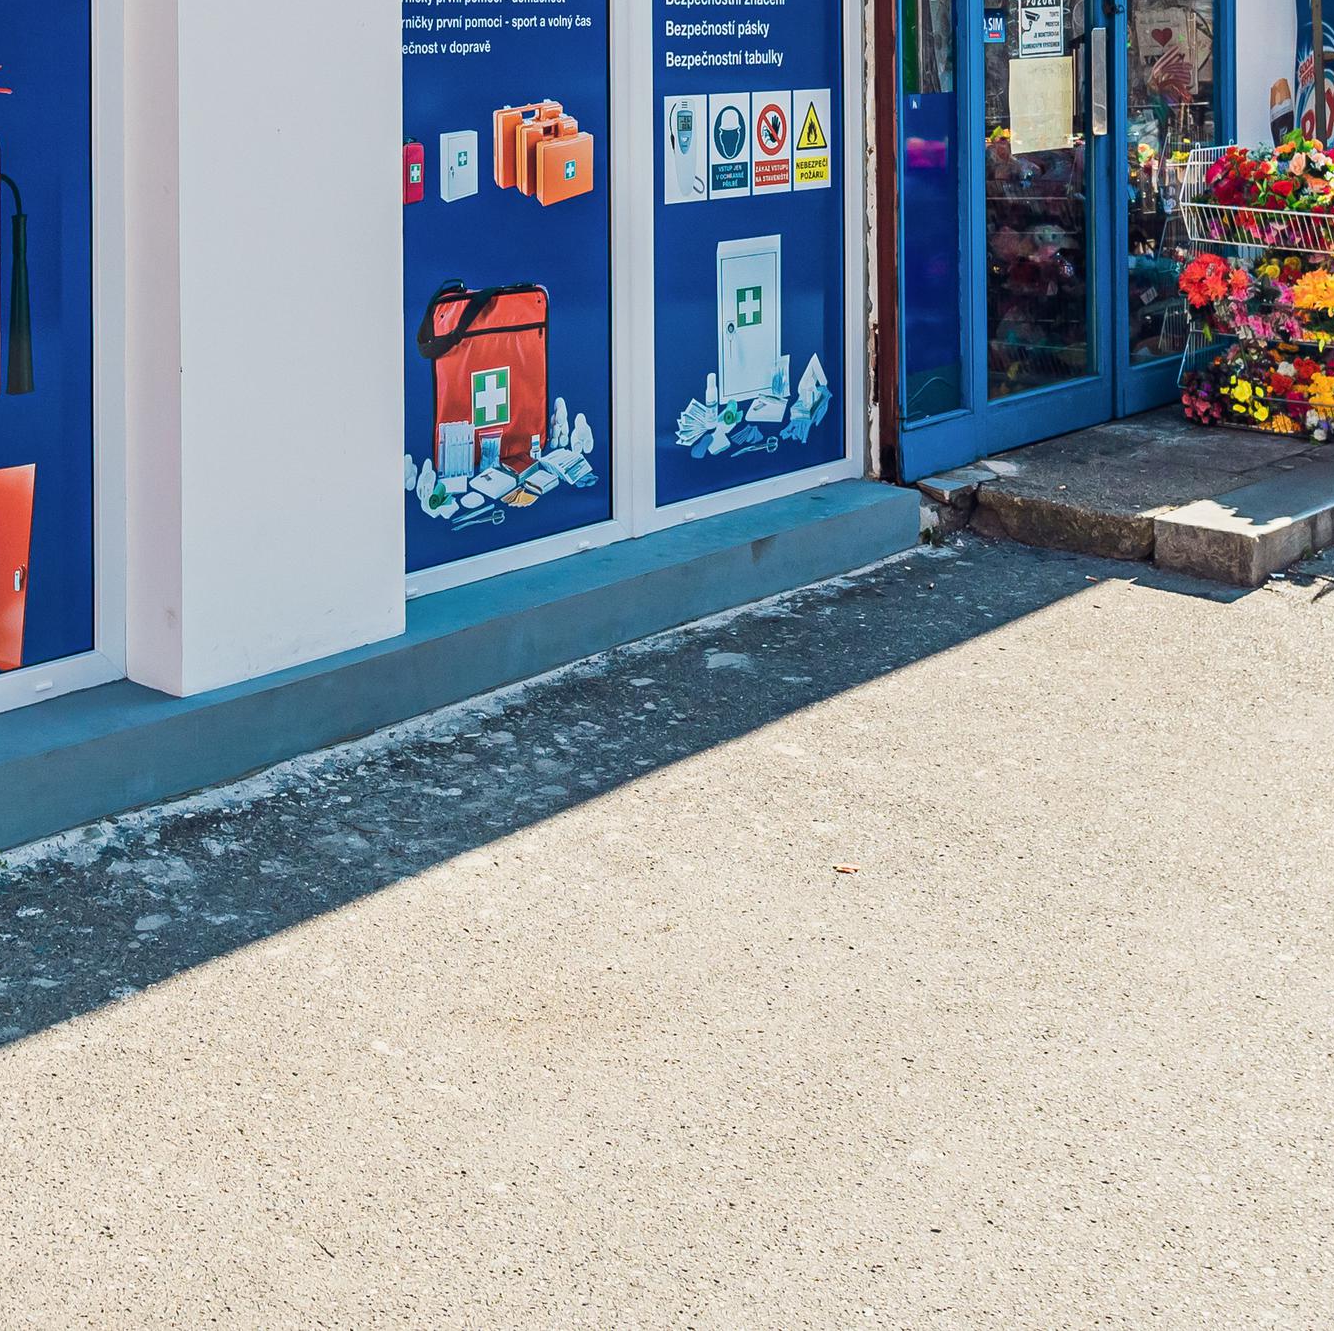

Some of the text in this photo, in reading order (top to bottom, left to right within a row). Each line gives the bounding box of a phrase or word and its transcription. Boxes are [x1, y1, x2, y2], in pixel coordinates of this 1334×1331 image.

[436, 16, 462, 31] první
[464, 15, 503, 31] pomoci
[511, 15, 537, 30] sport
[539, 18, 546, 27] a
[548, 15, 573, 30] volný
[575, 15, 592, 27] čas
[738, 20, 770, 40] pásky
[988, 17, 1003, 31] SIM
[440, 44, 447, 54] v
[449, 40, 491, 56] dopravě
[665, 49, 784, 70] Bezpečnostní tabulky
[755, 162, 789, 173] ZÁKAZ VSTUPU
[795, 157, 828, 169] NEBEZPEČÍ
[755, 174, 762, 183] NA
